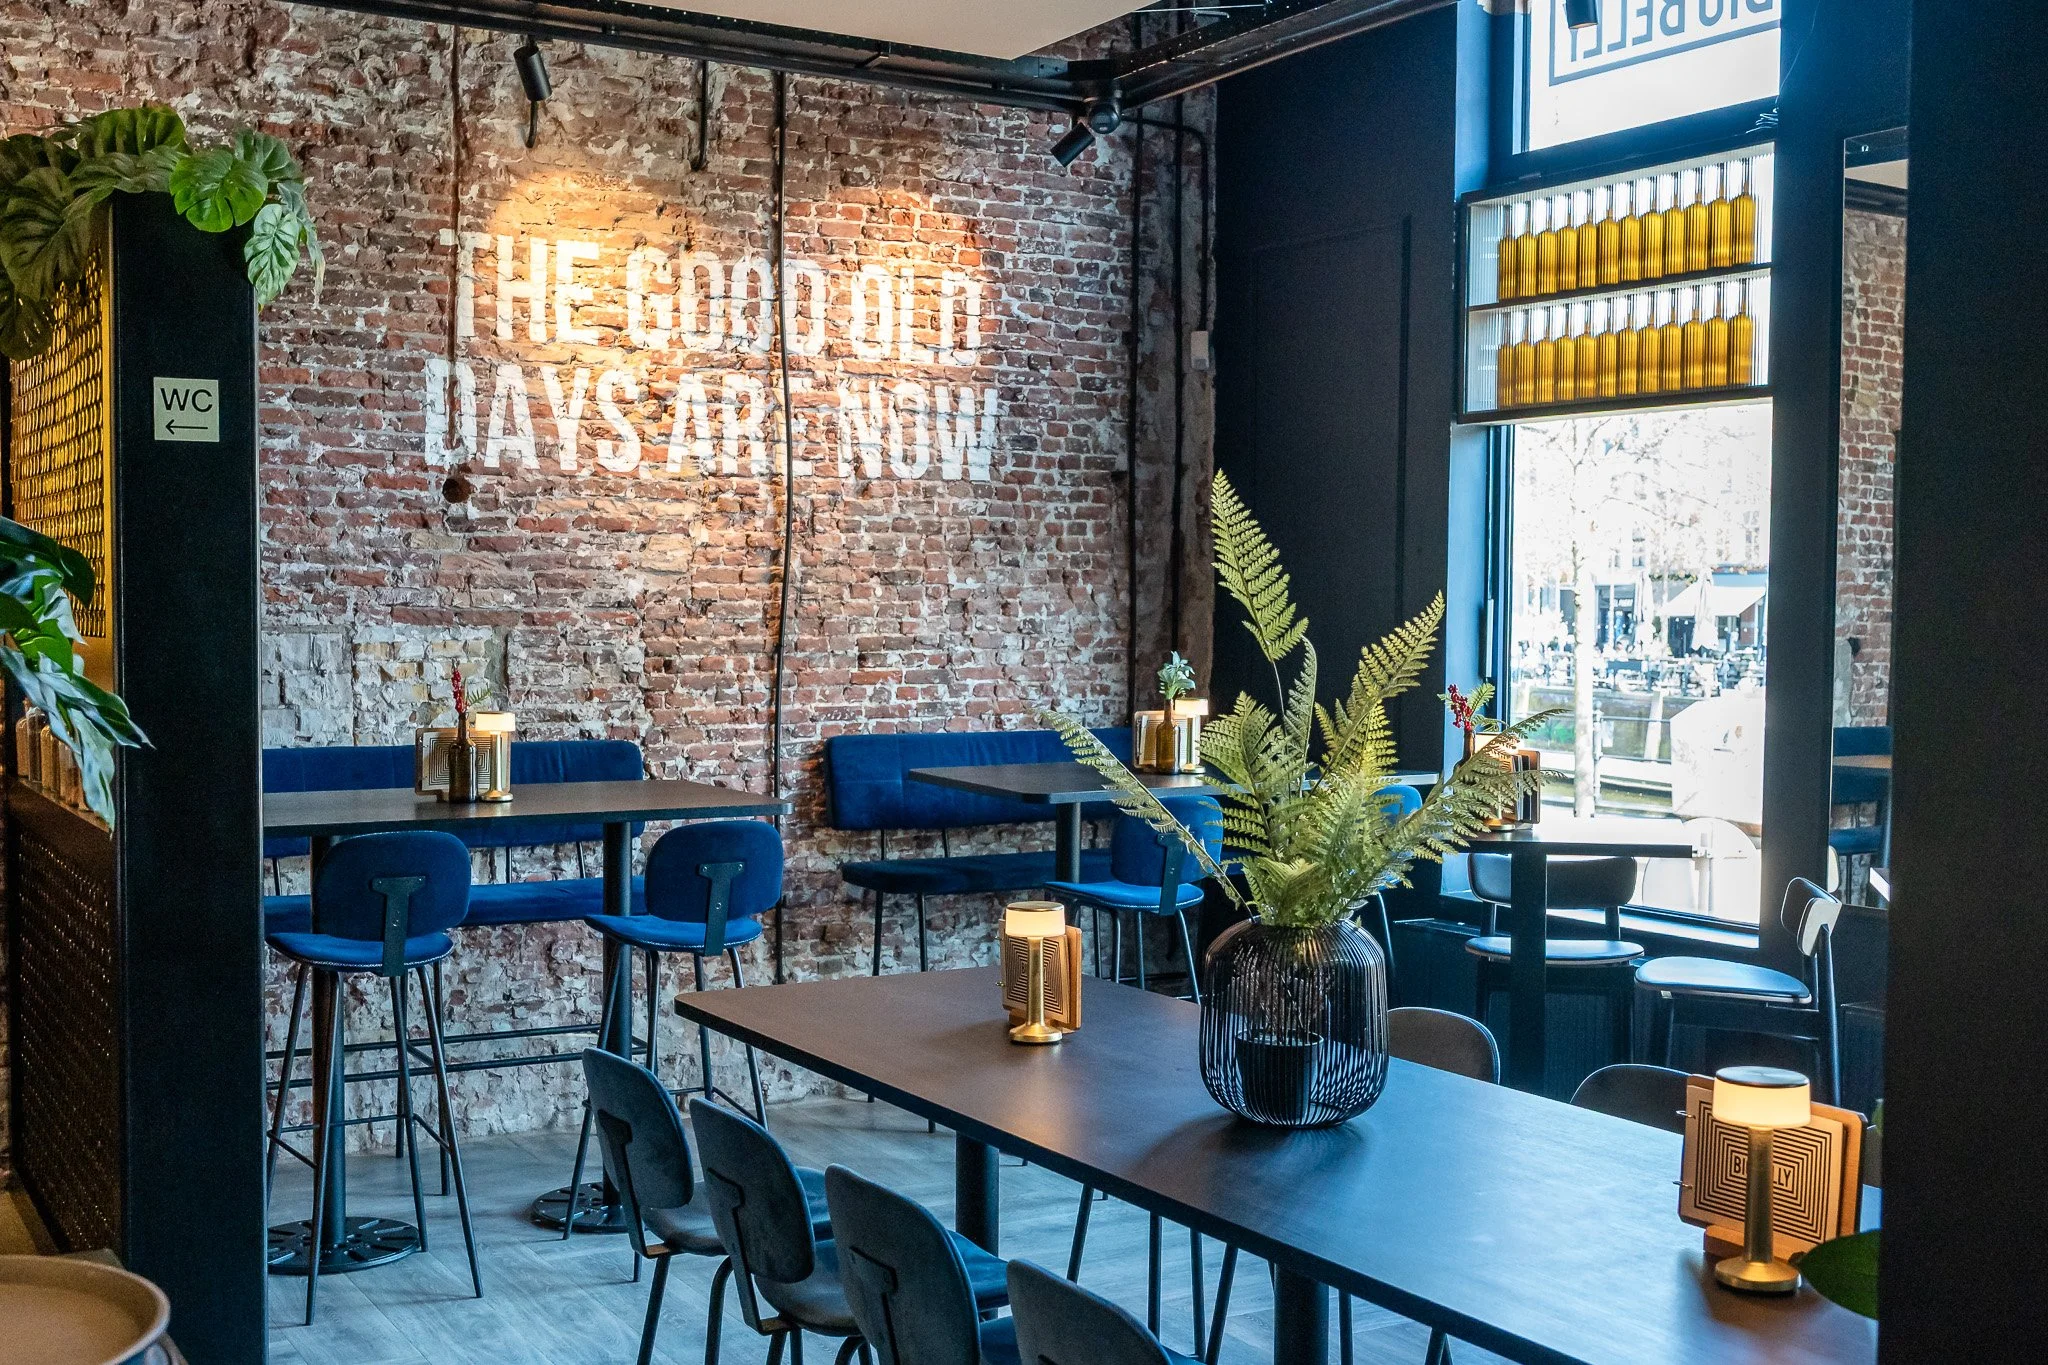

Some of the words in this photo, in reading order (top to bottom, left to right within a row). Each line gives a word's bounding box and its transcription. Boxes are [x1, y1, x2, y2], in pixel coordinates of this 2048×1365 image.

[439, 228, 602, 345] THE
[626, 247, 826, 356] GOOD
[850, 265, 981, 366] OLD
[161, 388, 213, 413] WC
[425, 358, 642, 474] DAYS
[665, 372, 814, 478] ARE
[838, 379, 999, 482] NOW
